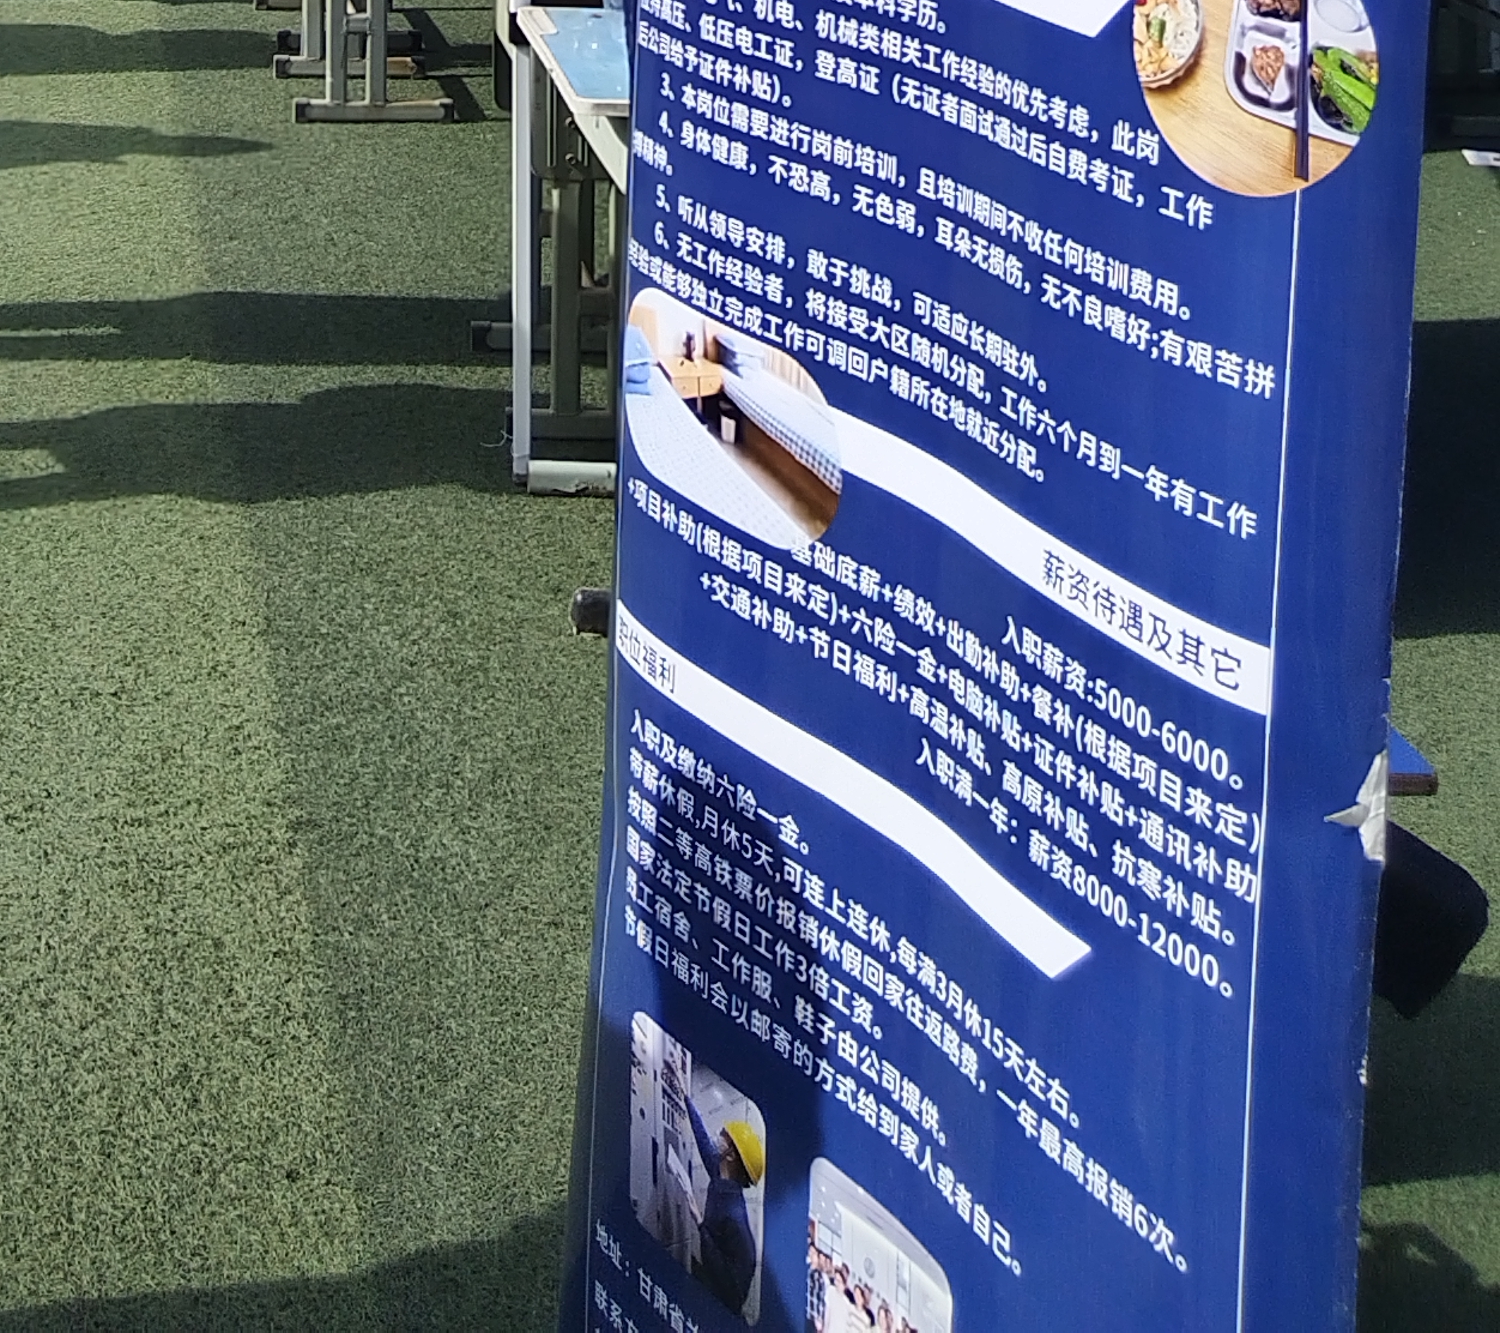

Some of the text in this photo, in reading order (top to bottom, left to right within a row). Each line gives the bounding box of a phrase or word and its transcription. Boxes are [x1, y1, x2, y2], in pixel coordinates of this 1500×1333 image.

[1042, 548, 1242, 691] 薪资待遇及其它
[630, 709, 812, 856] 入职及缴纳六险一金。
[626, 824, 882, 1041] 国家法定节假日工作3倍工资。
